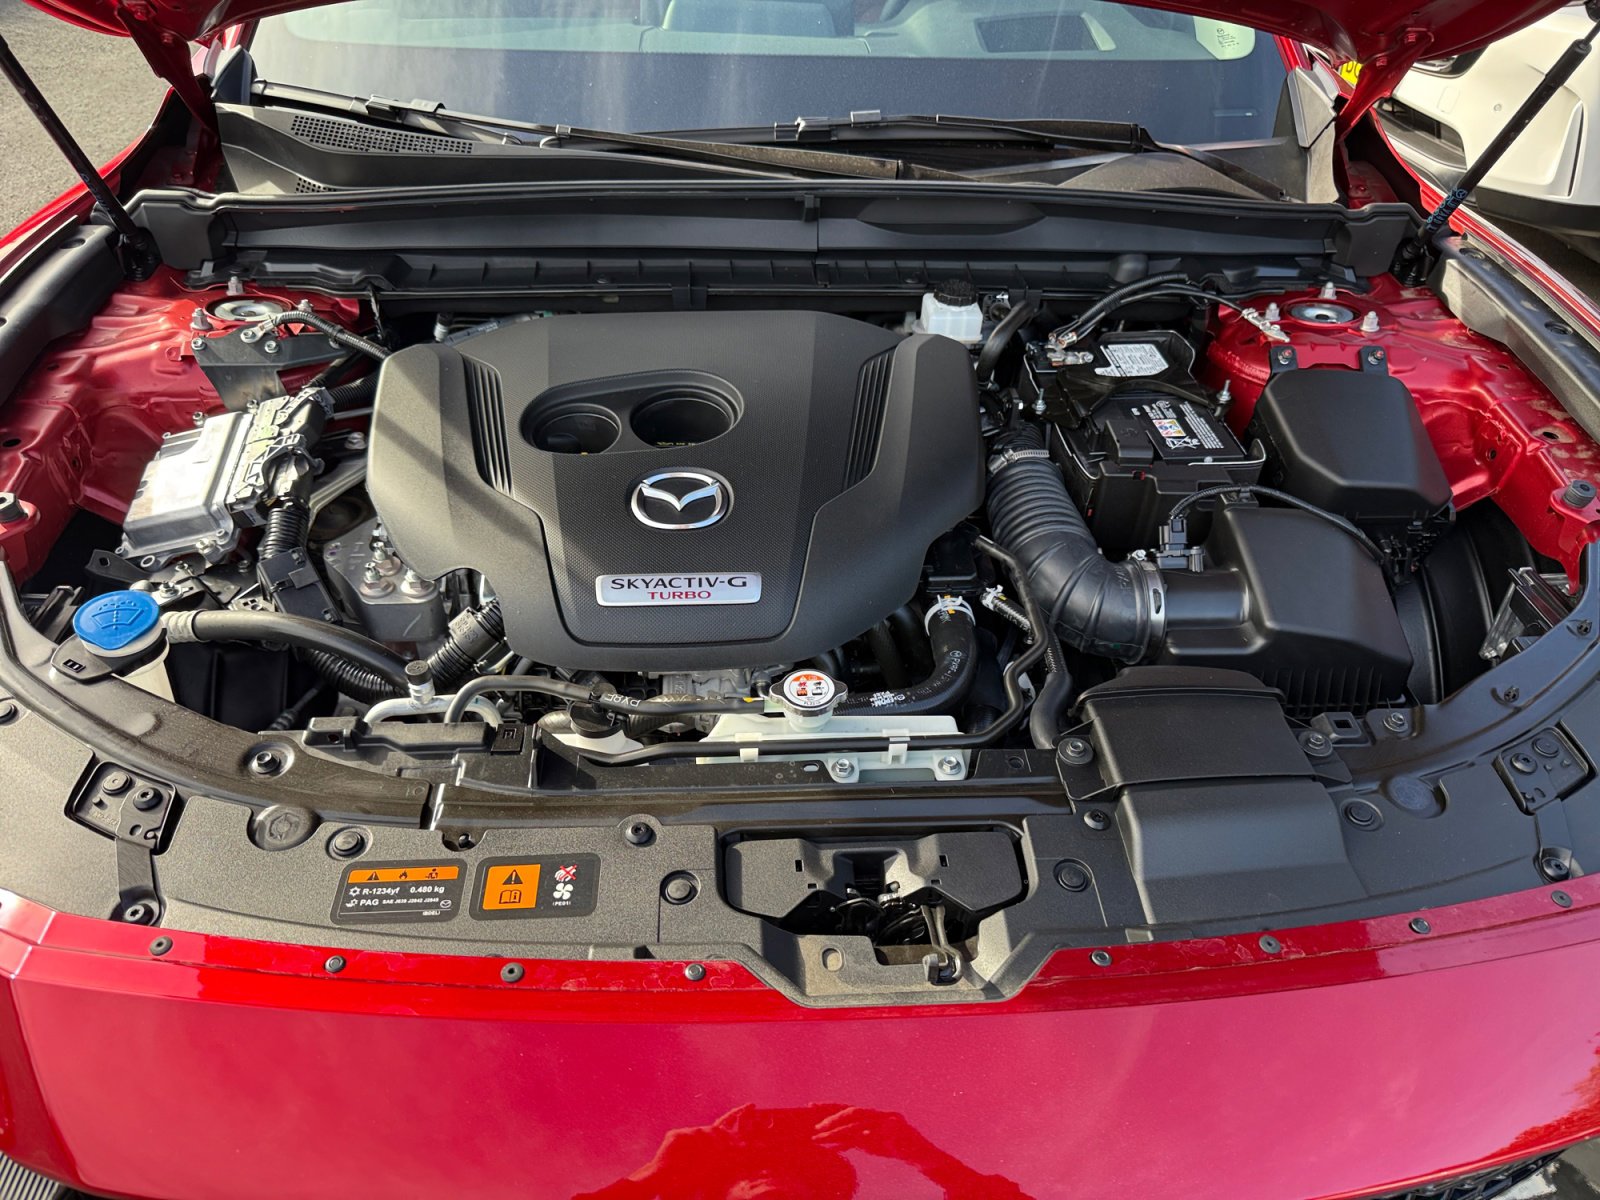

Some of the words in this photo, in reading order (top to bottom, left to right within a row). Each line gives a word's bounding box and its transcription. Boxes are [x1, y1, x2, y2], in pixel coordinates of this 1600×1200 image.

[610, 576, 748, 590] SKYACTIV-G
[647, 590, 711, 600] TURBO
[362, 887, 400, 896] R-1234yf
[433, 885, 445, 894] kg
